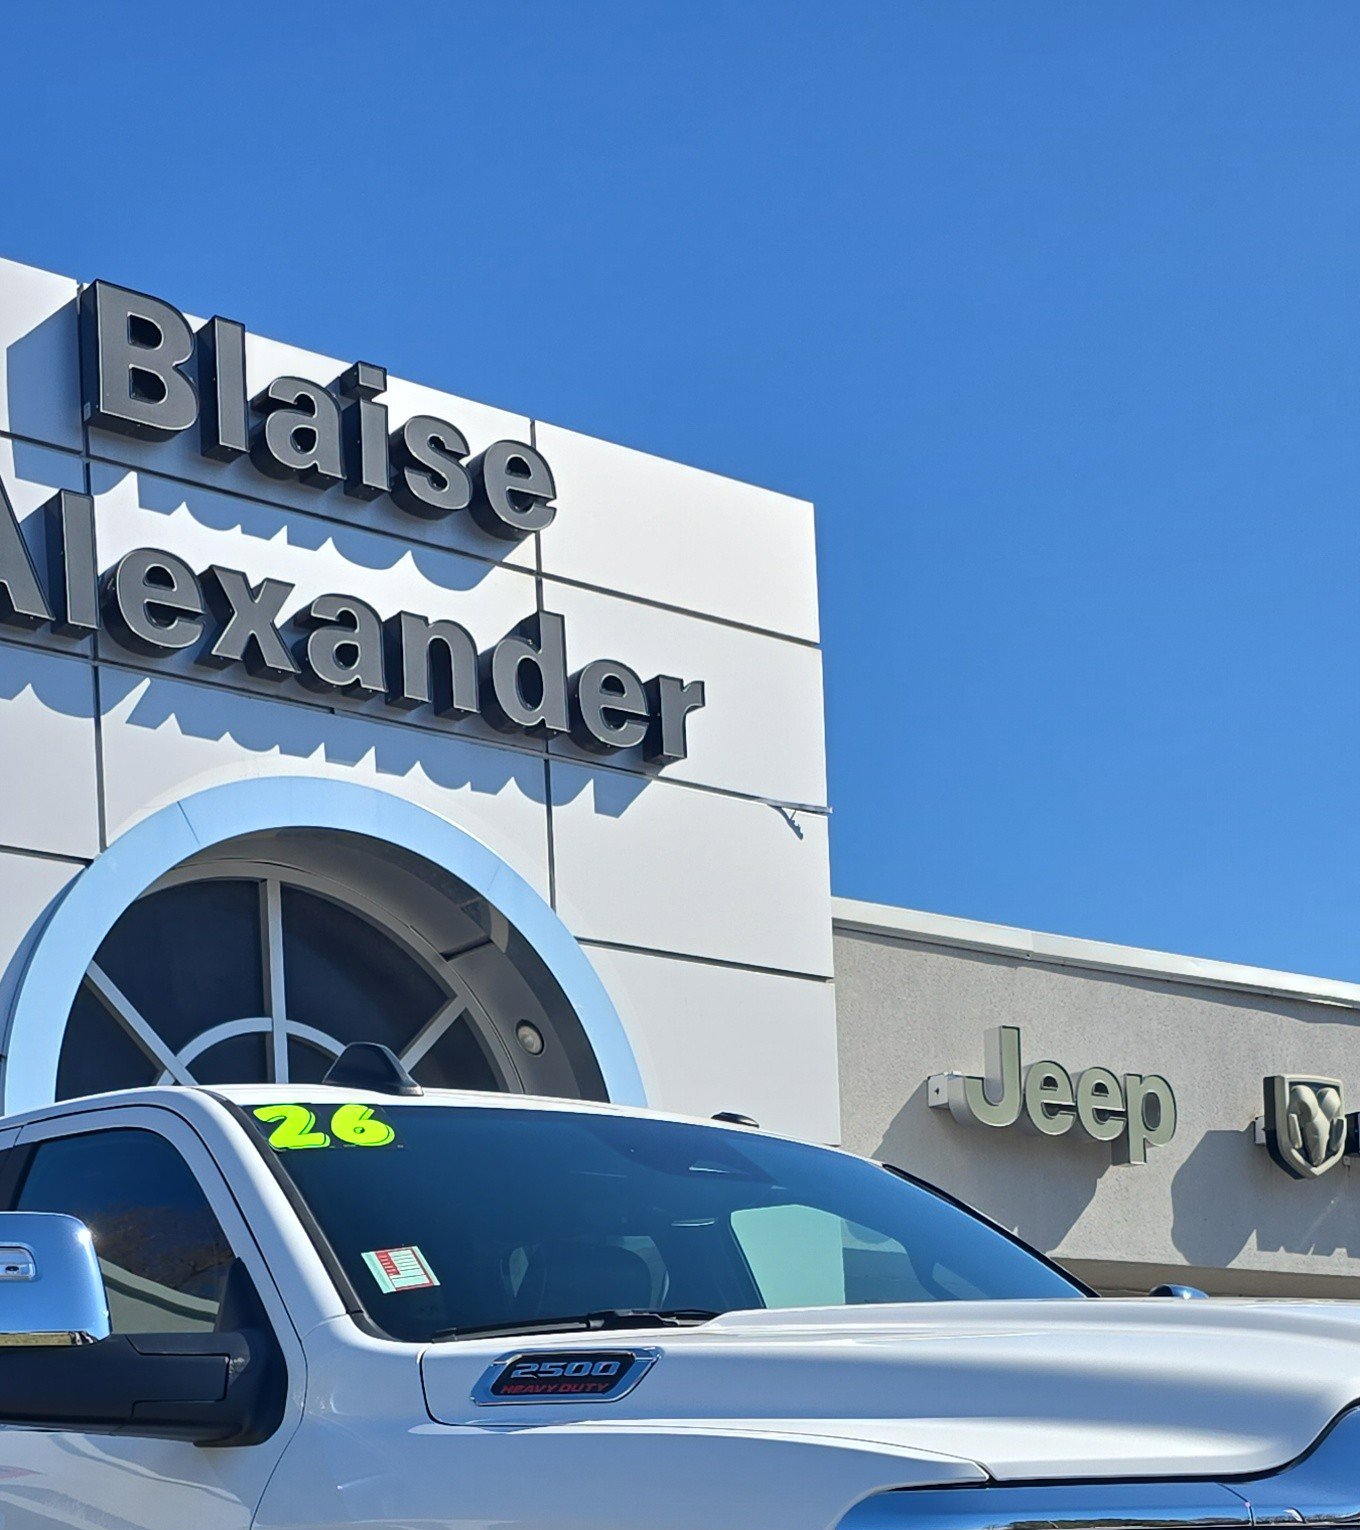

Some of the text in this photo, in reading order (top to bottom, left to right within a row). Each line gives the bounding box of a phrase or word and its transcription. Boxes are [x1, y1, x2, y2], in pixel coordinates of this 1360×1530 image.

[83, 280, 558, 541] Blaise
[948, 1026, 1177, 1165] Jeep
[253, 1104, 396, 1151] 26
[500, 1382, 609, 1394] HEAVY DUTY
[510, 1361, 621, 1379] 2500
